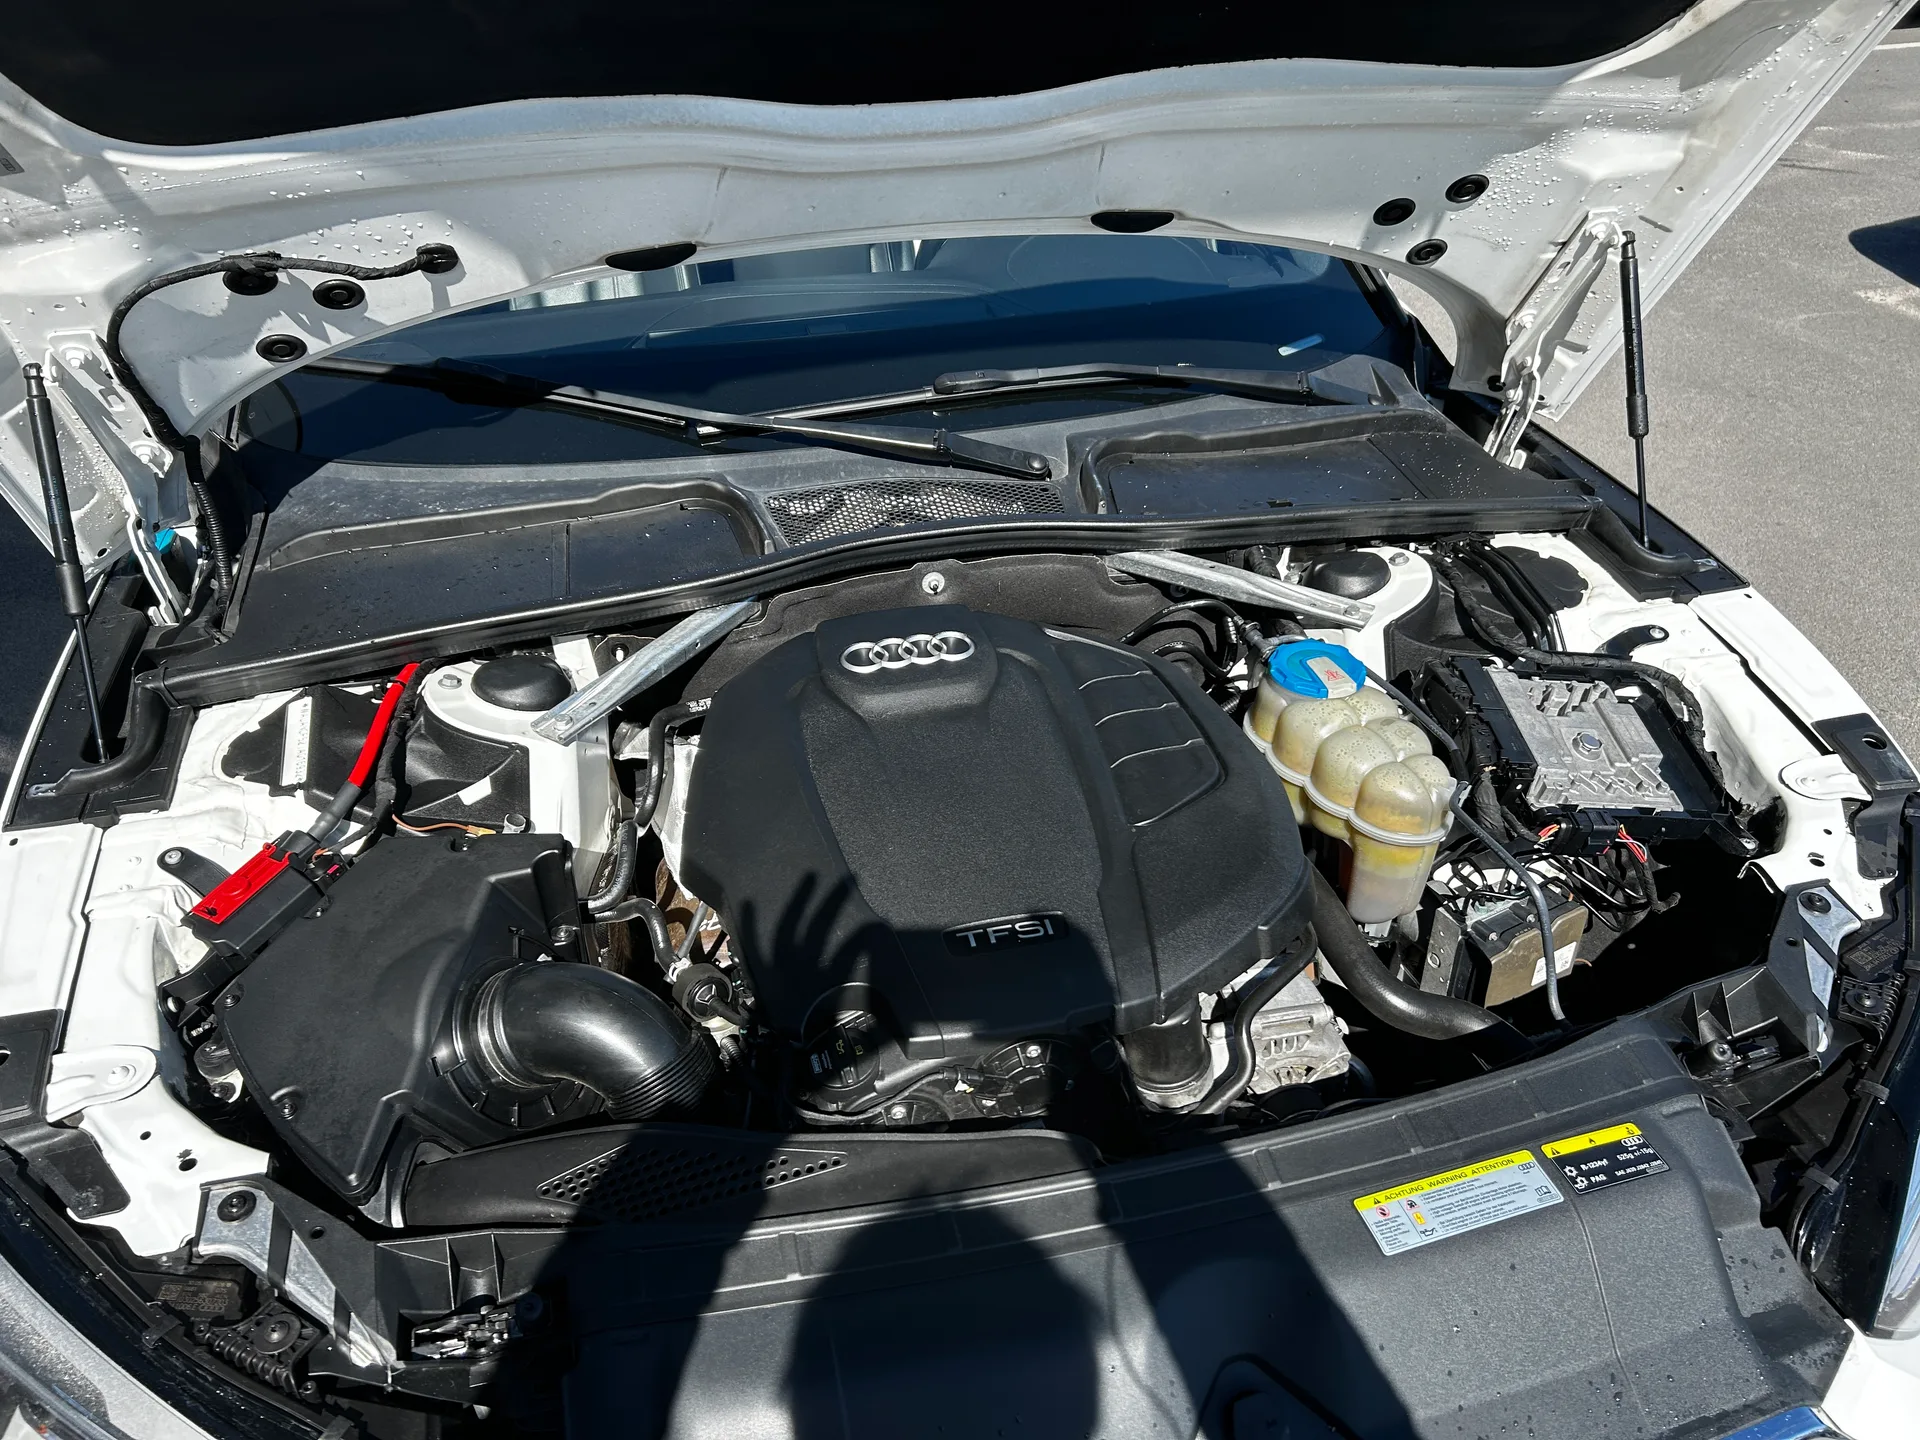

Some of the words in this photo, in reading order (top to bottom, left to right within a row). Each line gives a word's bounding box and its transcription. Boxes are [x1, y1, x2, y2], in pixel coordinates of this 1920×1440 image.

[956, 919, 1054, 947] TFSI
[1384, 1185, 1424, 1200] ACHTUNG
[1427, 1172, 1468, 1187] WARNING
[1471, 1158, 1514, 1175] ATTENTION
[1590, 1174, 1607, 1182] PAG
